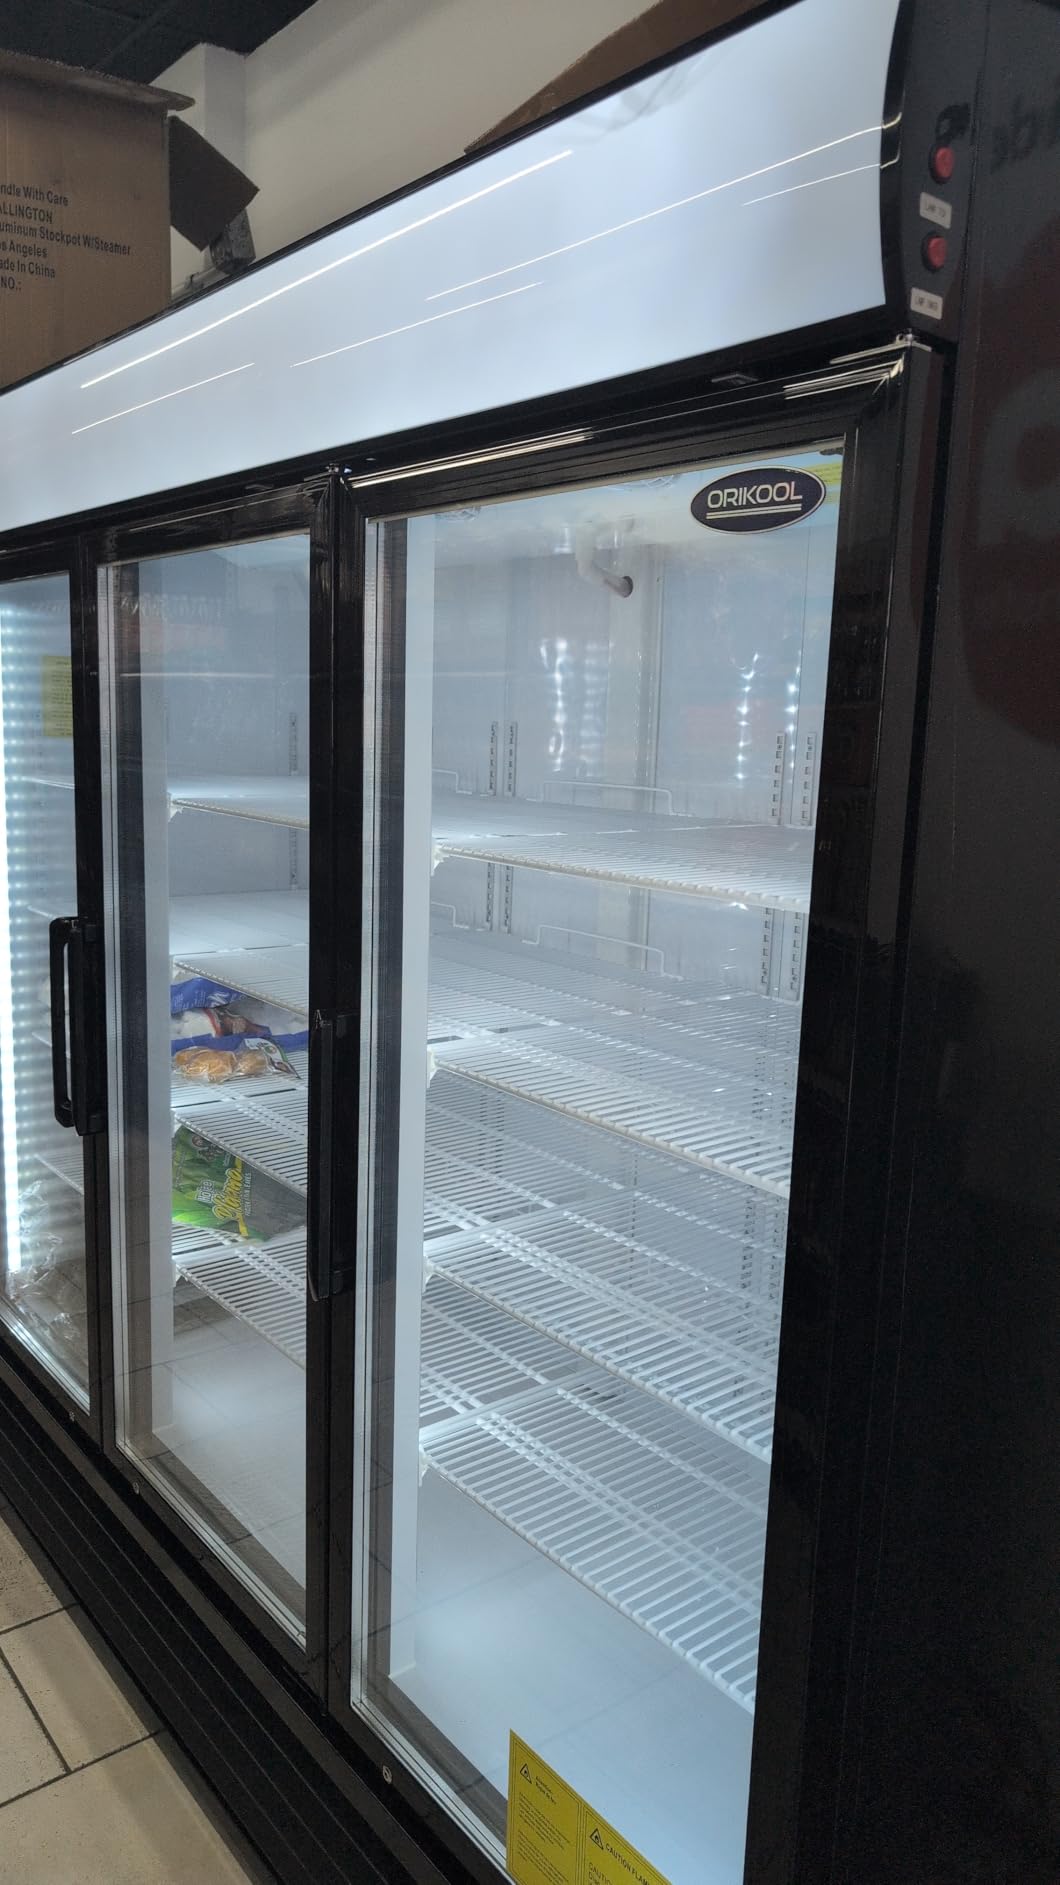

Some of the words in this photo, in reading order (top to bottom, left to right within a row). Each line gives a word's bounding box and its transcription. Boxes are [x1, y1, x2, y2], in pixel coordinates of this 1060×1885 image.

[23, 186, 44, 201] With
[46, 190, 69, 207] Care
[9, 241, 48, 258] Angeles
[39, 226, 81, 247] Stockpot
[83, 234, 131, 256] W/Steamer
[17, 260, 26, 274] In
[28, 261, 55, 279] China
[706, 480, 803, 510] ORIKOOL
[605, 1842, 632, 1872] CAUTION
